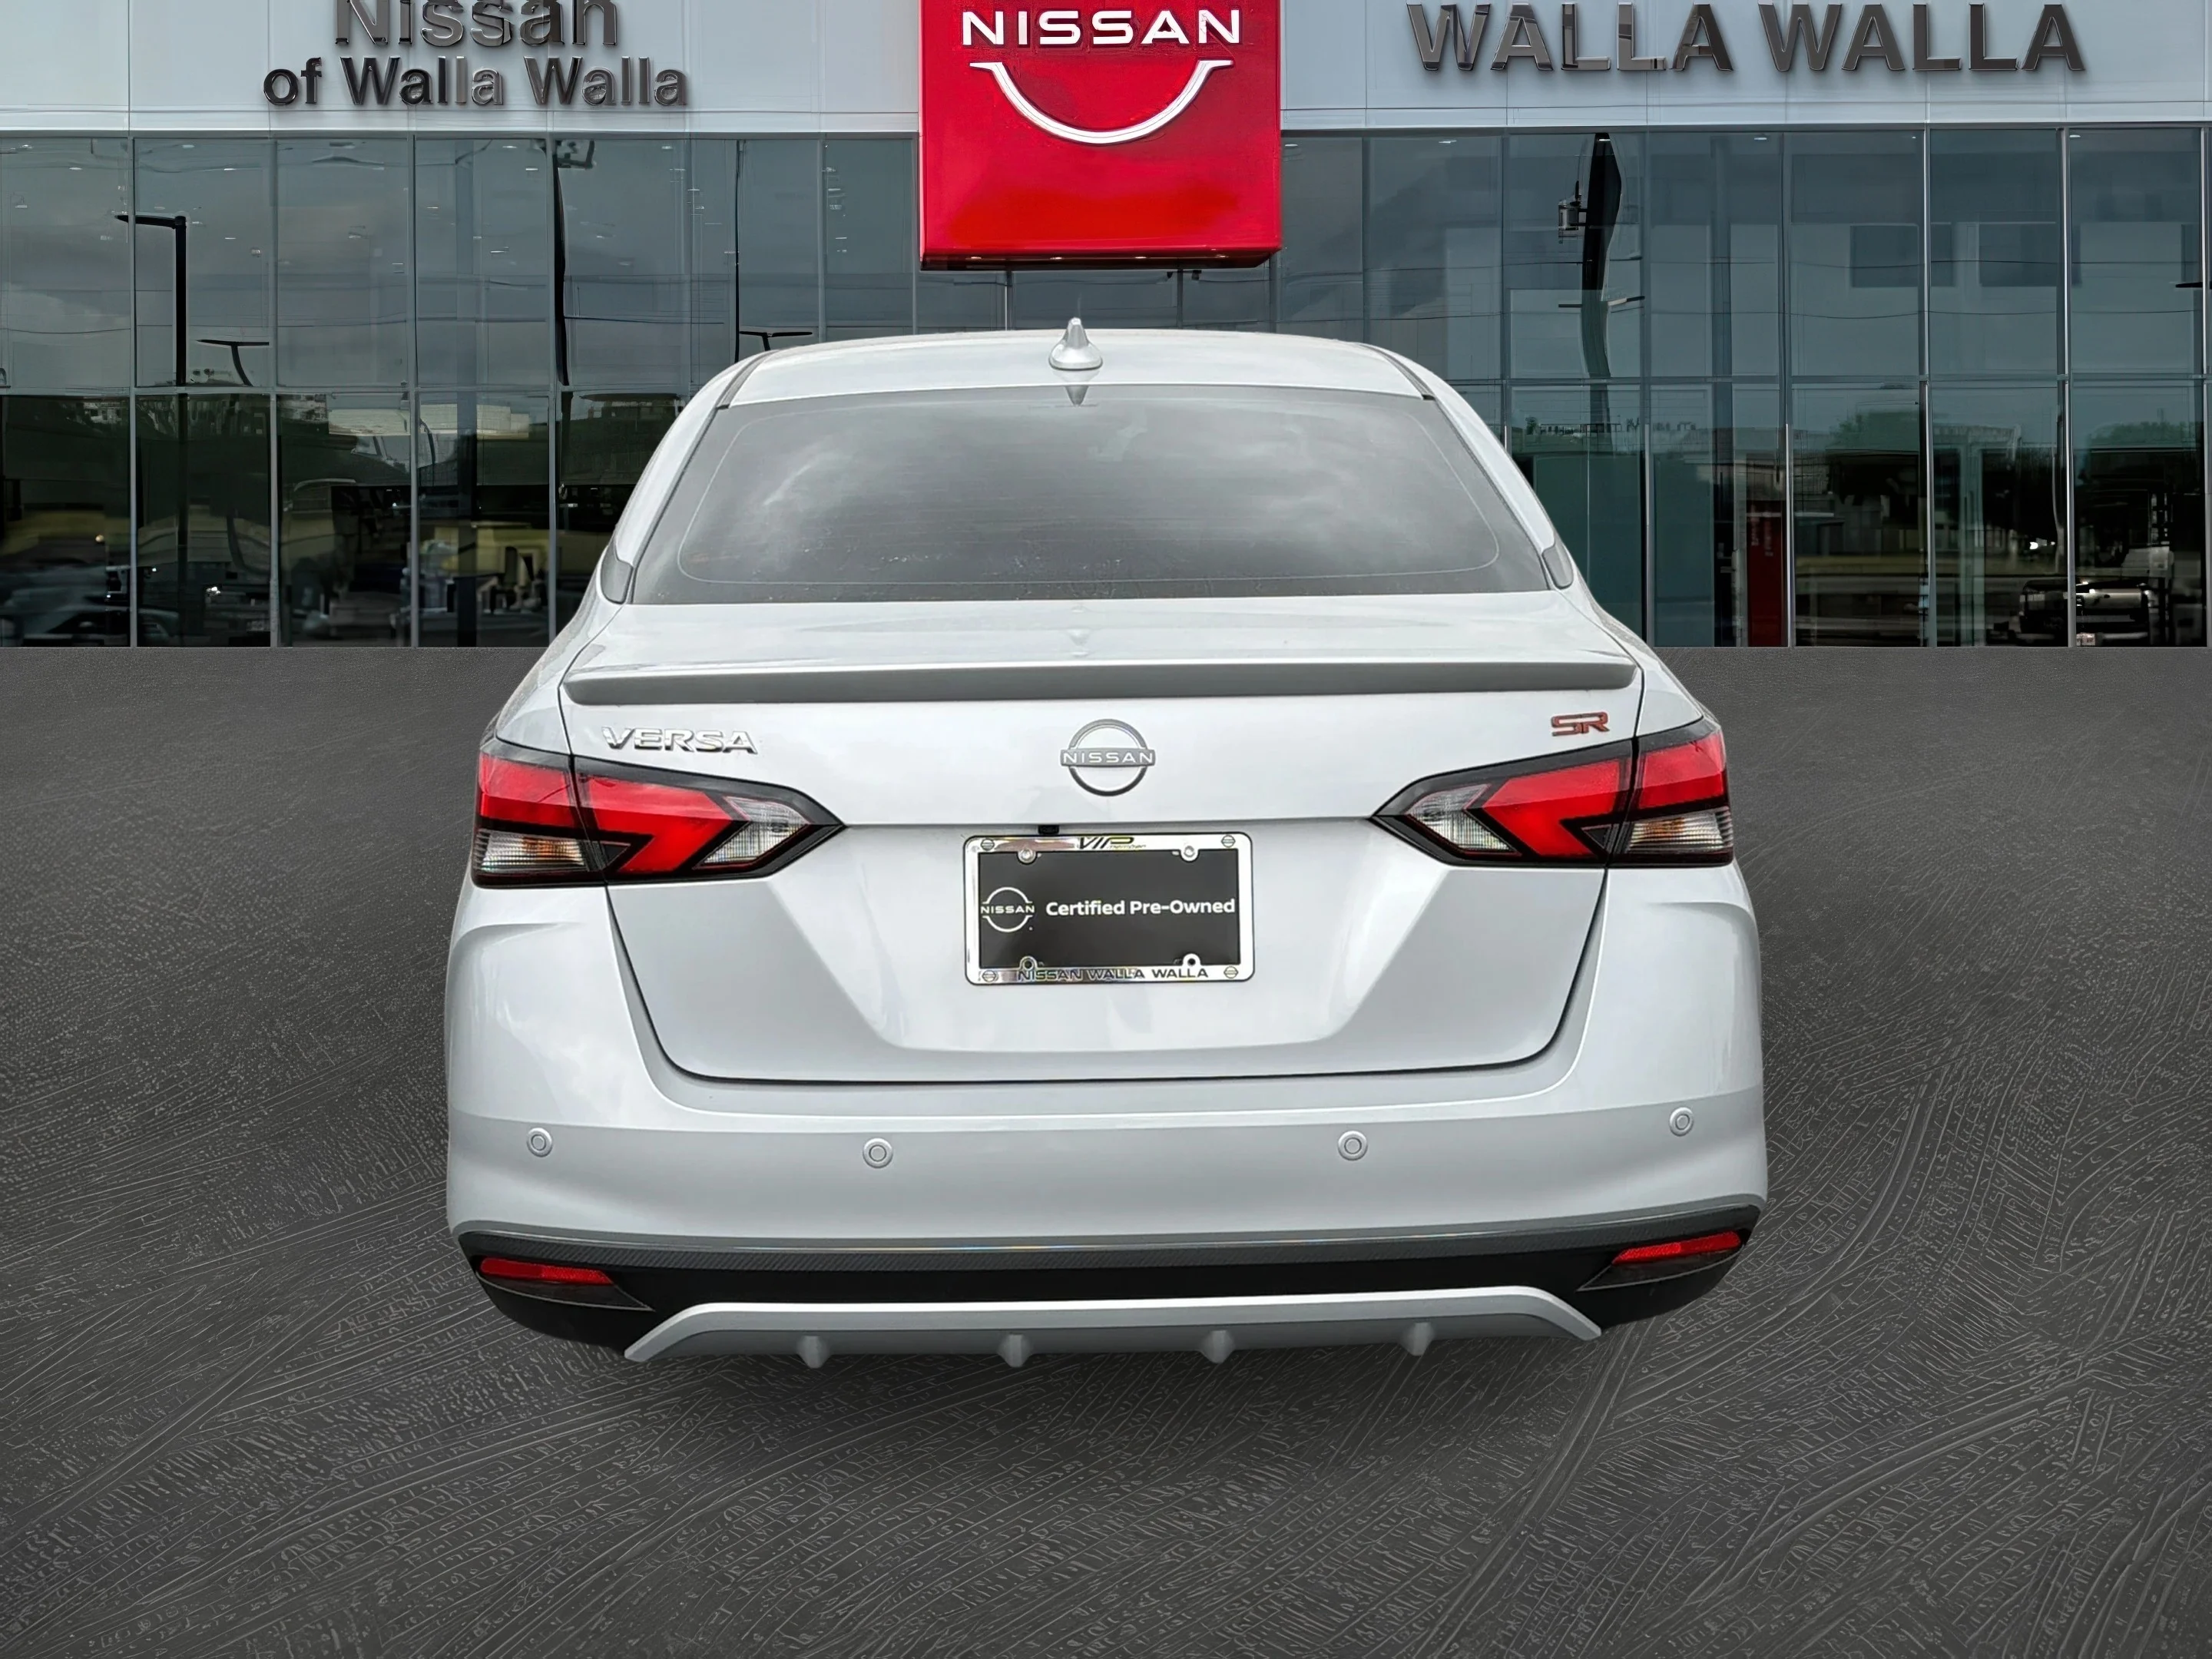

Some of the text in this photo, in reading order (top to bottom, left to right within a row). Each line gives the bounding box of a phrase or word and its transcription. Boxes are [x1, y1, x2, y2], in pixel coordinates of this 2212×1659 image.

[334, 0, 618, 46] Nissan
[962, 9, 1240, 46] NISSAN
[1406, 3, 2085, 72] WALLA WALLA
[263, 55, 687, 106] of Walla Walla
[1551, 711, 1610, 737] SR
[601, 726, 758, 755] VERSA
[1063, 752, 1153, 763] NISSAN
[1079, 836, 1134, 849] VIP
[981, 905, 1035, 914] NISSAN
[1045, 898, 1236, 916] Certified Pre-Owned
[1018, 968, 1209, 982] NISSAN WALLA WALLA
